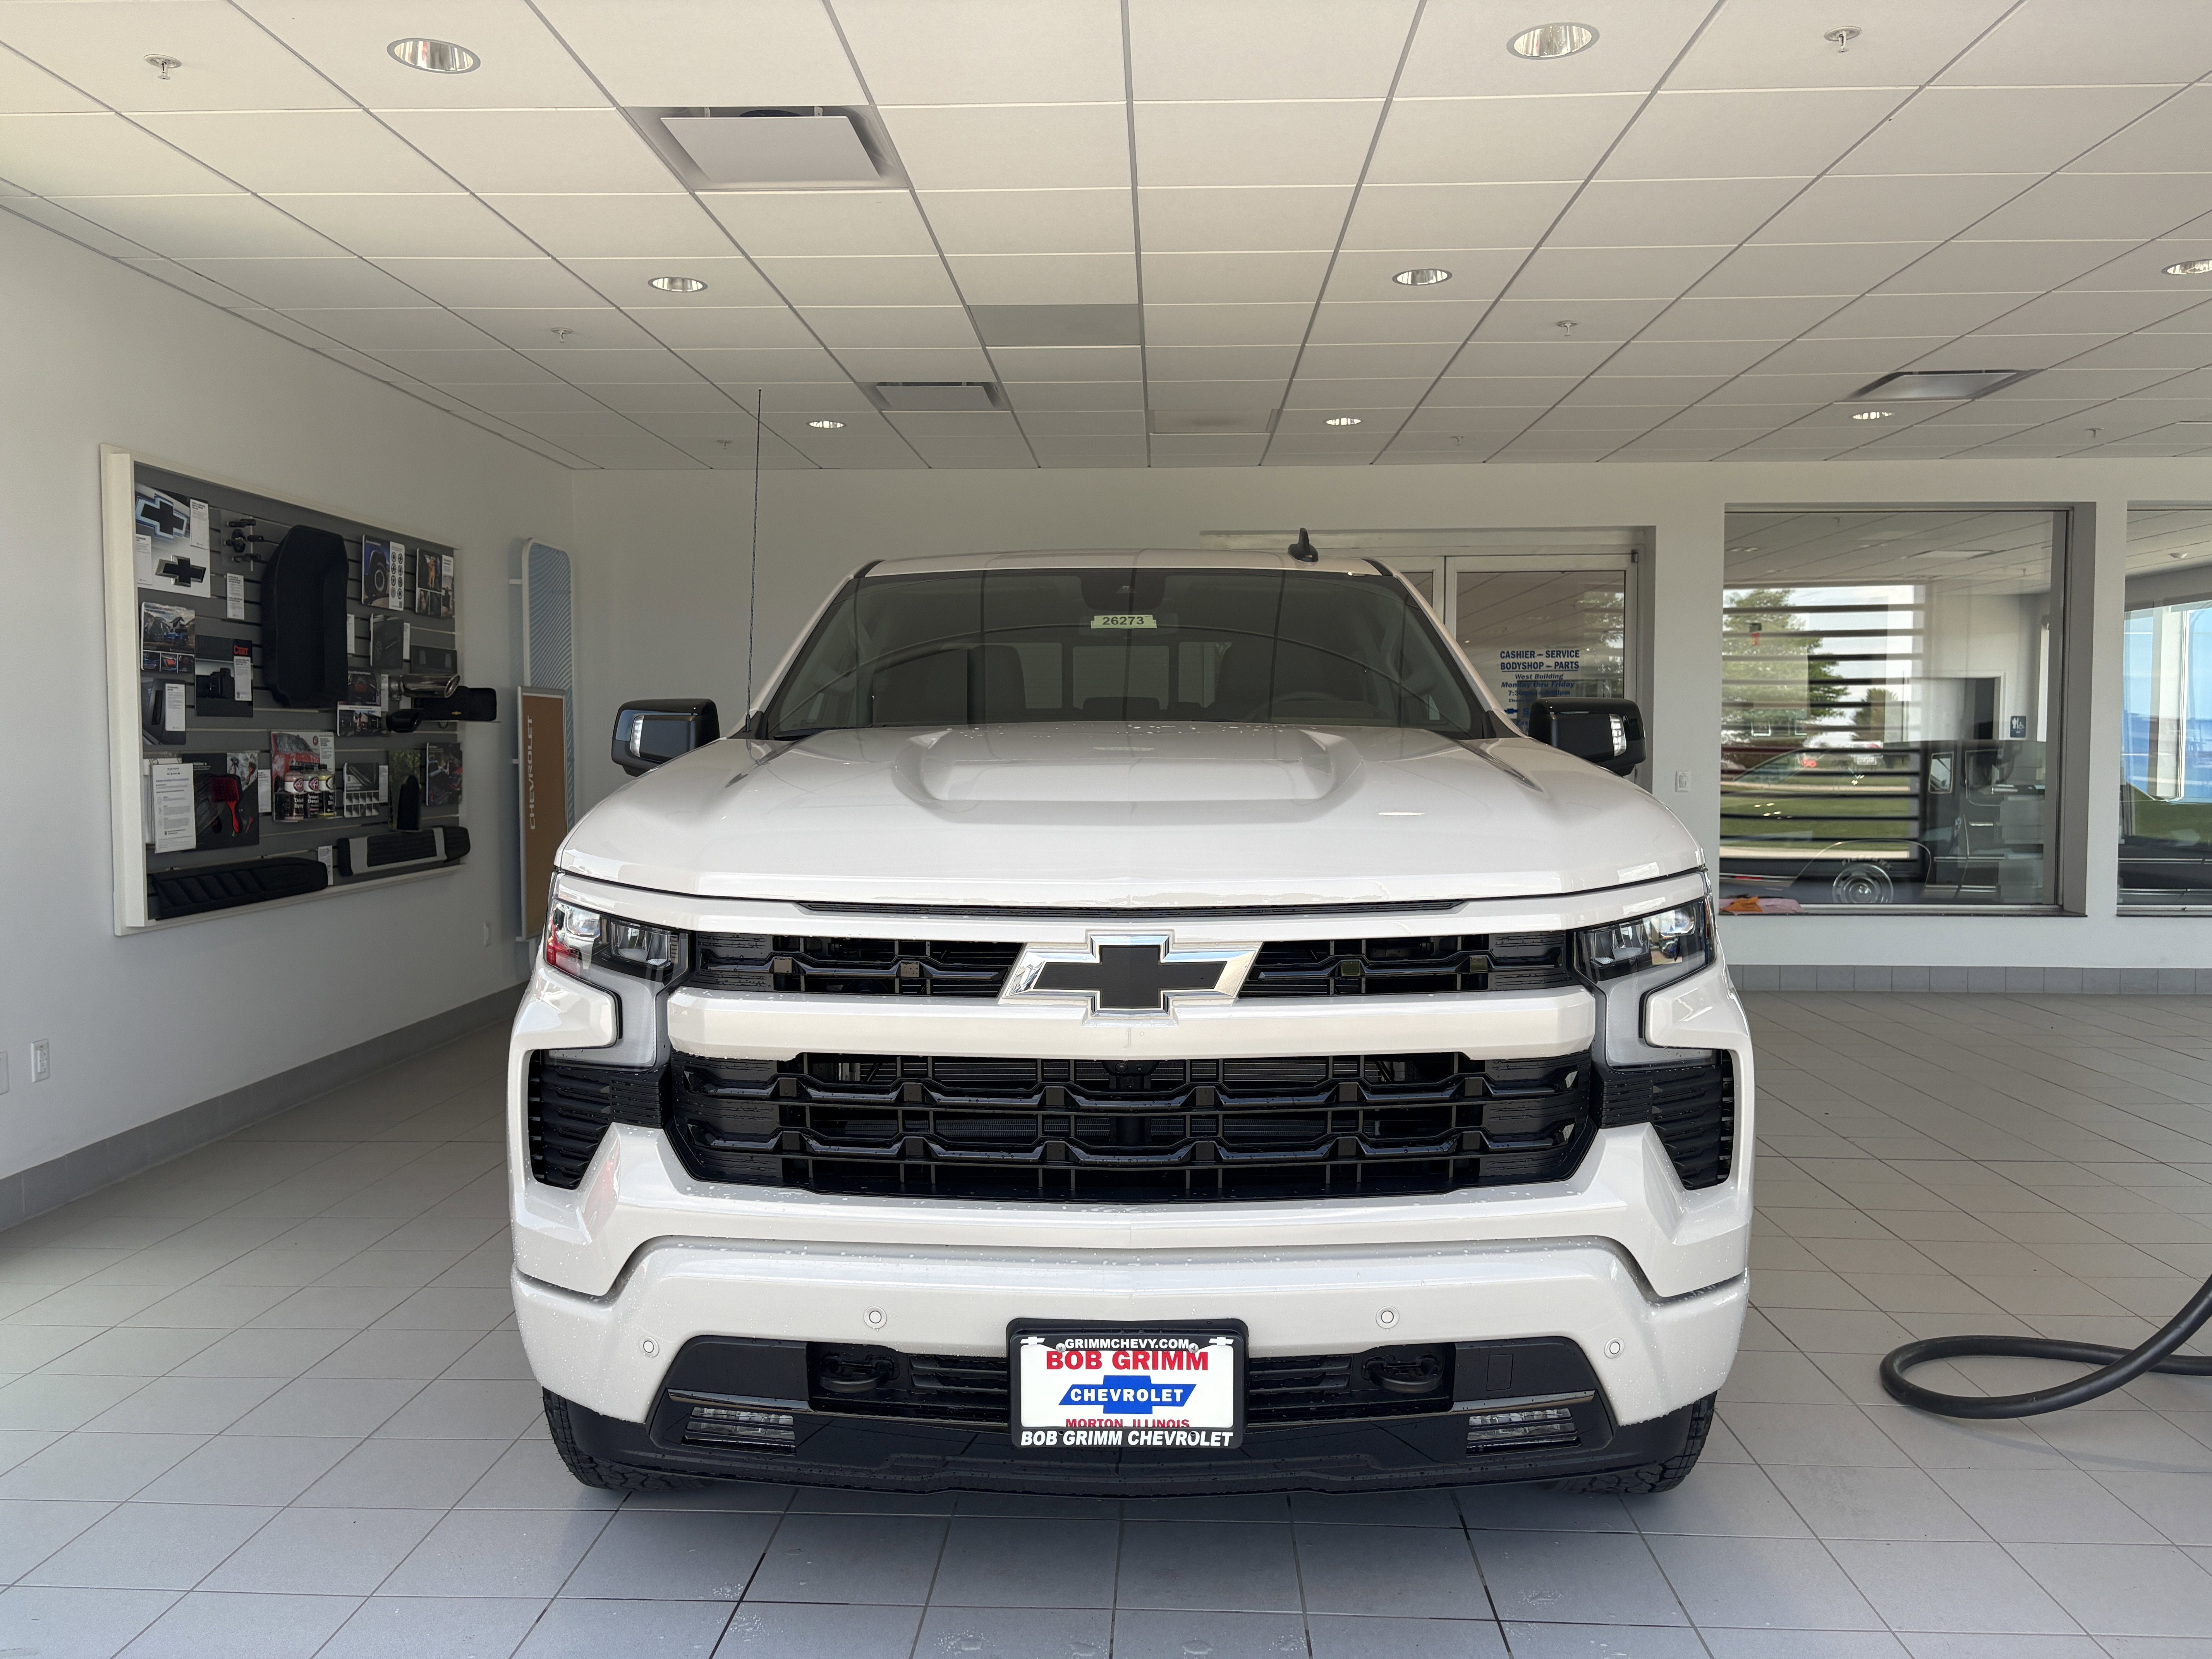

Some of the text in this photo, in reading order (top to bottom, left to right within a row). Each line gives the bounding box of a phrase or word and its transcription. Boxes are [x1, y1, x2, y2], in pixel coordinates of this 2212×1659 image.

[1103, 617, 1144, 625] 26273
[1500, 651, 1535, 659] CASHIER
[1546, 650, 1580, 658] SERVICE
[1501, 662, 1544, 670] BODYSHOP
[527, 715, 536, 830] CHEVROLET
[1065, 1338, 1189, 1349] GRIMMCHEVY.COM
[1047, 1351, 1208, 1370] BOB GRIMM
[1070, 1388, 1183, 1401] CHEVROLET
[1066, 1419, 1123, 1427] MORTON
[1021, 1431, 1233, 1446] BOB GRIMM CHEVROLET
